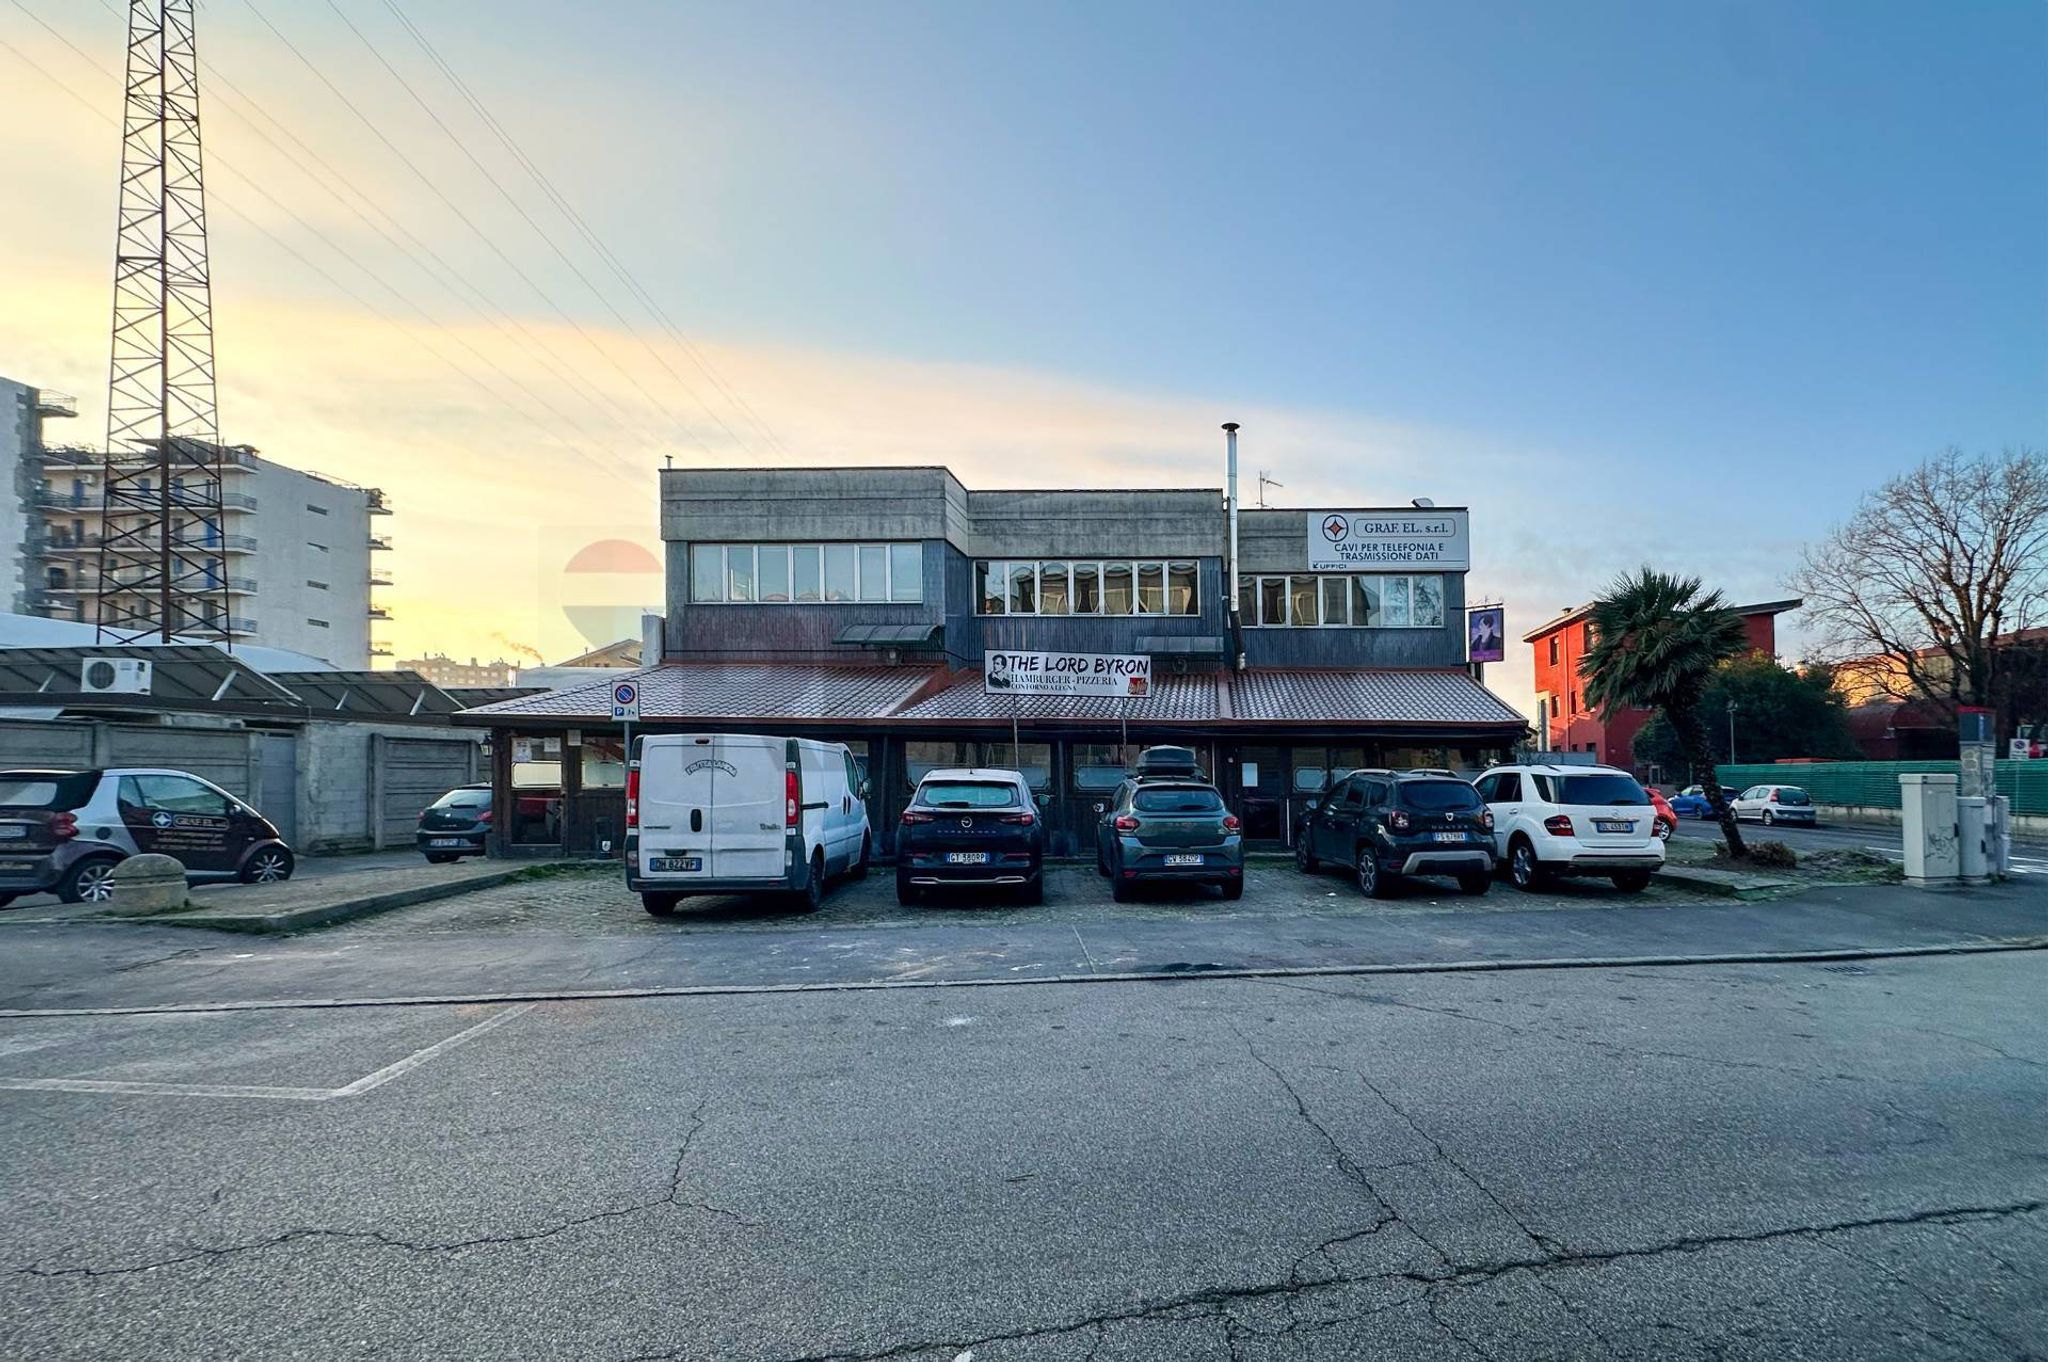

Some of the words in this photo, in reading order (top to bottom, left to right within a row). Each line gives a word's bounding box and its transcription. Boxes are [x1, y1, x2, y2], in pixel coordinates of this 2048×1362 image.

[1403, 523, 1422, 534] EL.
[1425, 523, 1449, 533] s.r.l.
[1334, 543, 1358, 552] CAVI
[1361, 543, 1378, 552] PER
[1382, 543, 1435, 552] TELEFONIA
[1438, 543, 1444, 551] E
[1340, 552, 1413, 560] TRASMISSIONE
[1415, 552, 1439, 560] DATI
[1007, 655, 1039, 672] THE
[1045, 657, 1089, 675] LORD
[1094, 658, 1149, 677] BYRON
[1011, 674, 1070, 684] HAMBURGER
[1076, 676, 1118, 686] PIZZERIA
